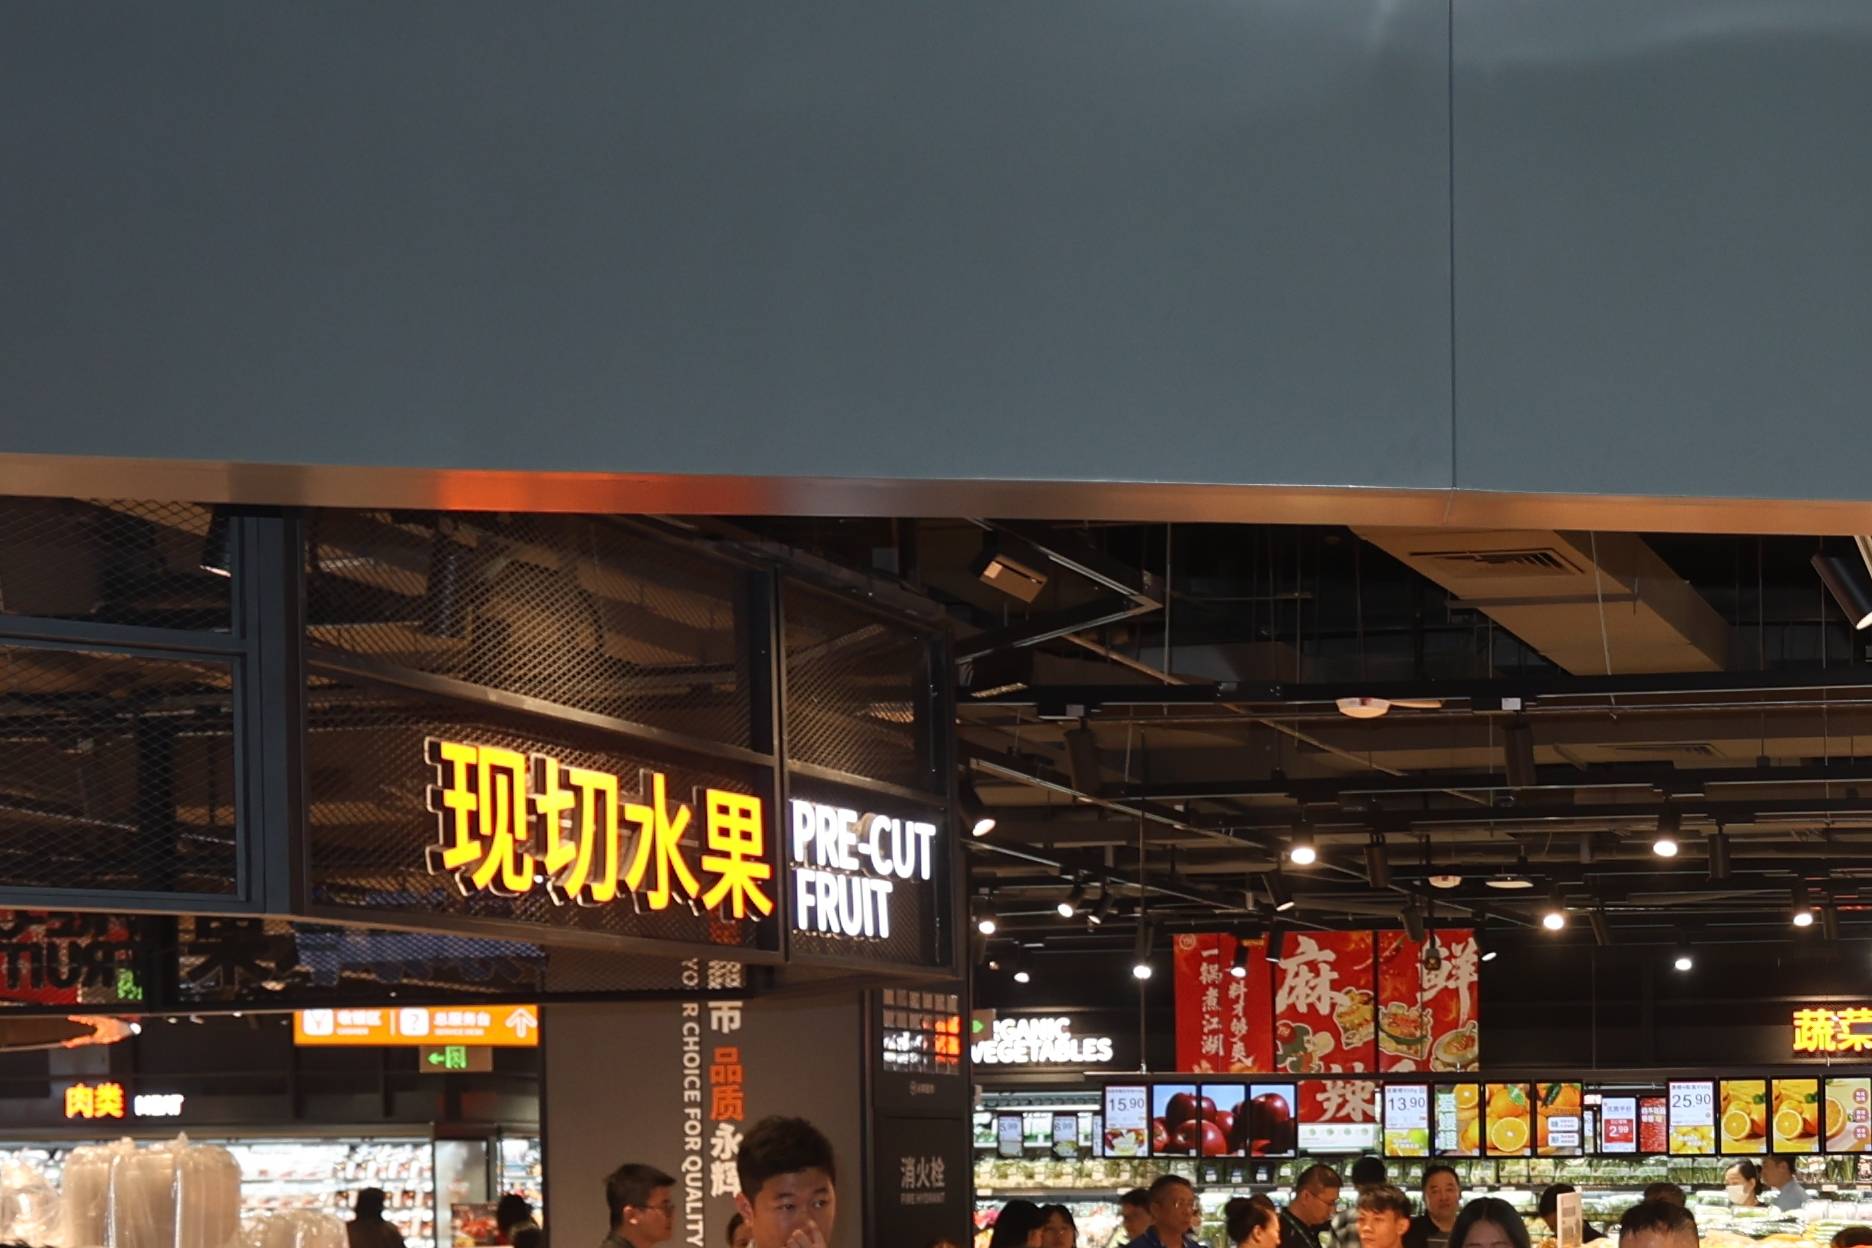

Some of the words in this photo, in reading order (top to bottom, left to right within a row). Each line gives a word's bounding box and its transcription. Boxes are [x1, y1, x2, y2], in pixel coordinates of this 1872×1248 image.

[440, 741, 774, 919] 现切水果
[793, 798, 936, 881] PRE-CUT
[798, 868, 893, 939] FRUIT
[682, 957, 699, 1017] YOR
[1222, 960, 1255, 1067] 料才够爽
[682, 1023, 700, 1102] CHOICE
[971, 1038, 1113, 1064] VEGETABLES
[65, 1083, 125, 1118] 肉类
[1110, 1098, 1145, 1112] 15.90
[1388, 1096, 1426, 1111] 13.90
[1672, 1093, 1712, 1109] 25.90
[684, 1108, 701, 1150] FOR
[900, 1156, 945, 1188] 消火栓
[682, 1158, 704, 1247] QUALITY
